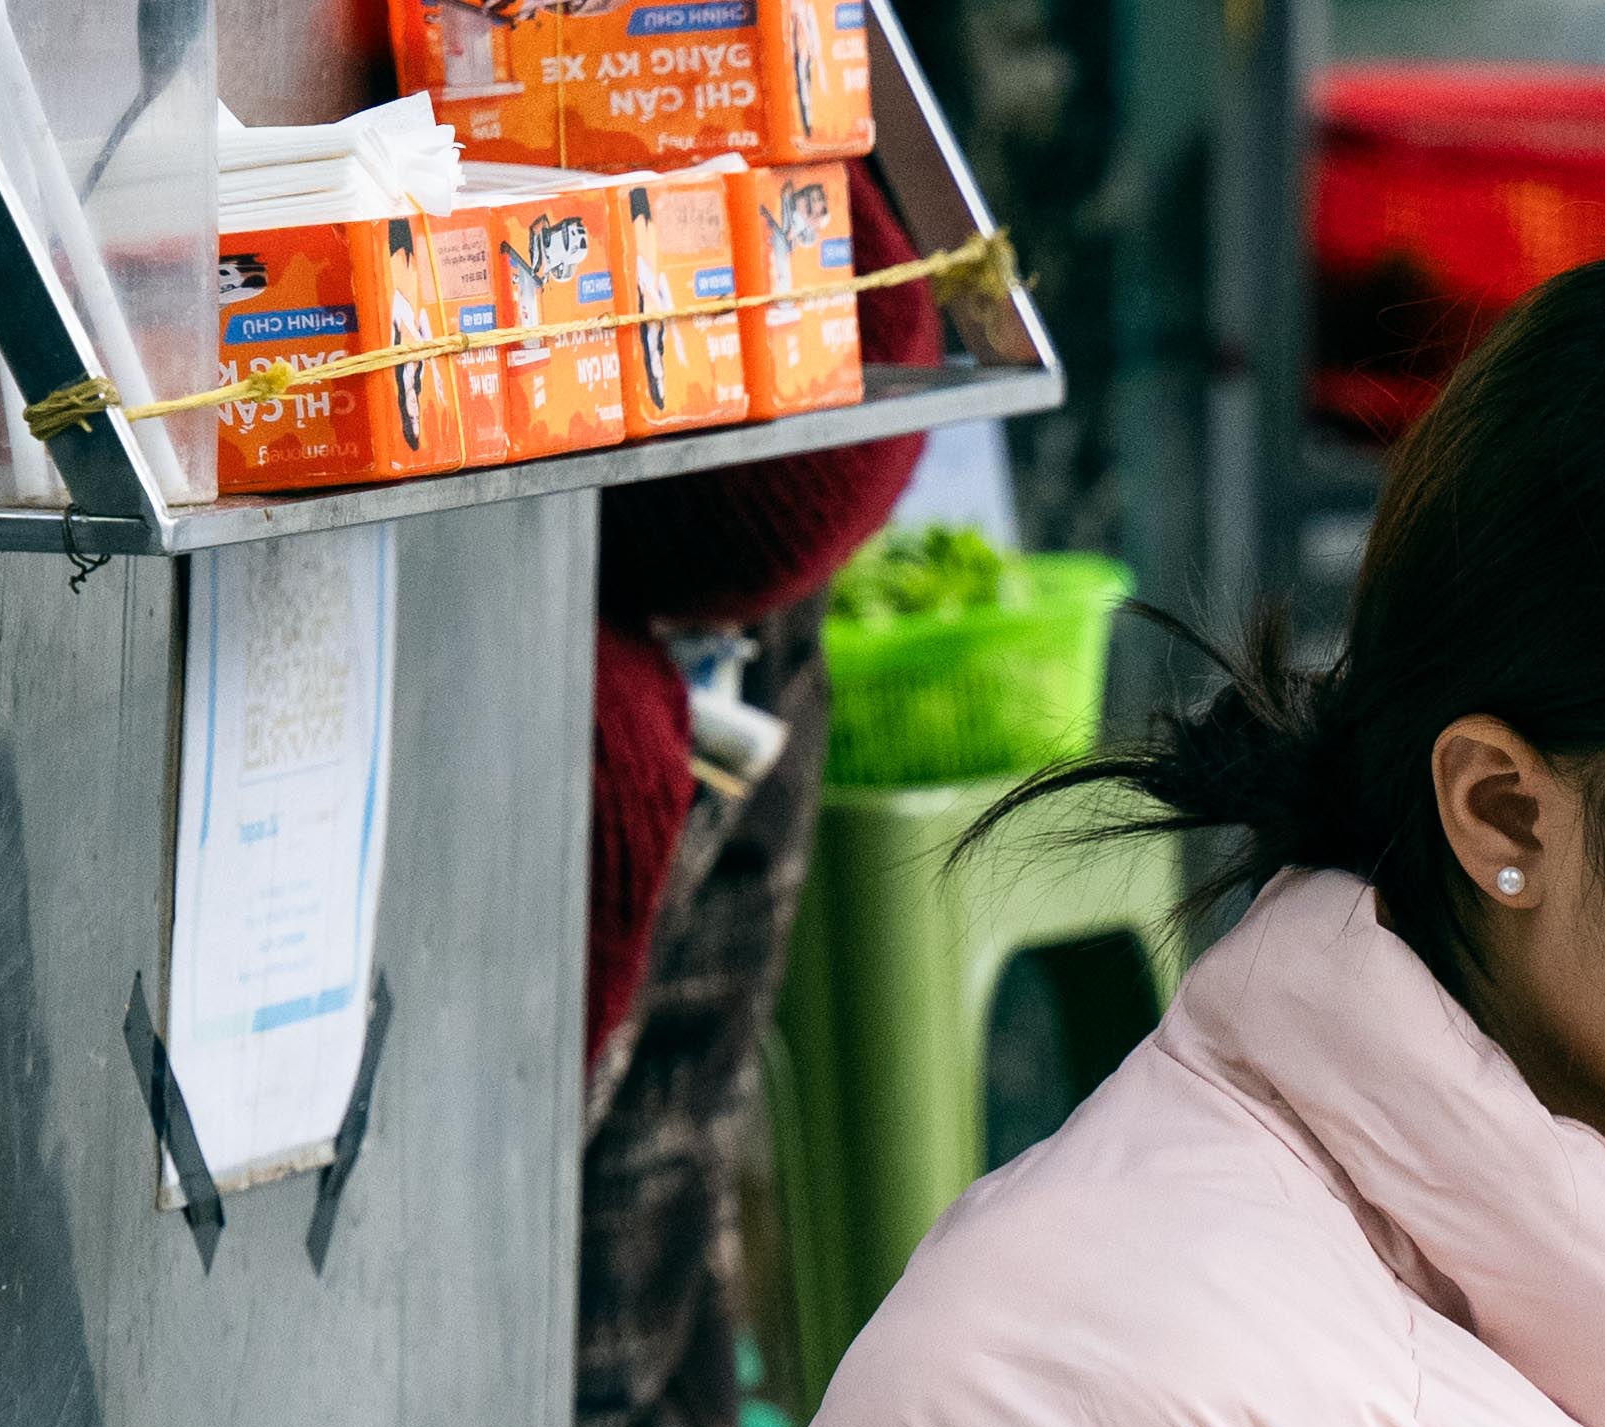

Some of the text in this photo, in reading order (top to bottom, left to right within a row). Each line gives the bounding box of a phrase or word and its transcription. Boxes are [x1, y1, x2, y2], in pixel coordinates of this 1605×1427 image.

[689, 2, 747, 27] CHÍNH
[541, 42, 752, 84] ĐĂNG KÝ XE
[610, 79, 756, 123] CHỈ CẦN
[242, 312, 348, 340] CHÍNH CHỦ
[295, 390, 356, 429] CHỈ
[257, 442, 360, 467] truemoney
